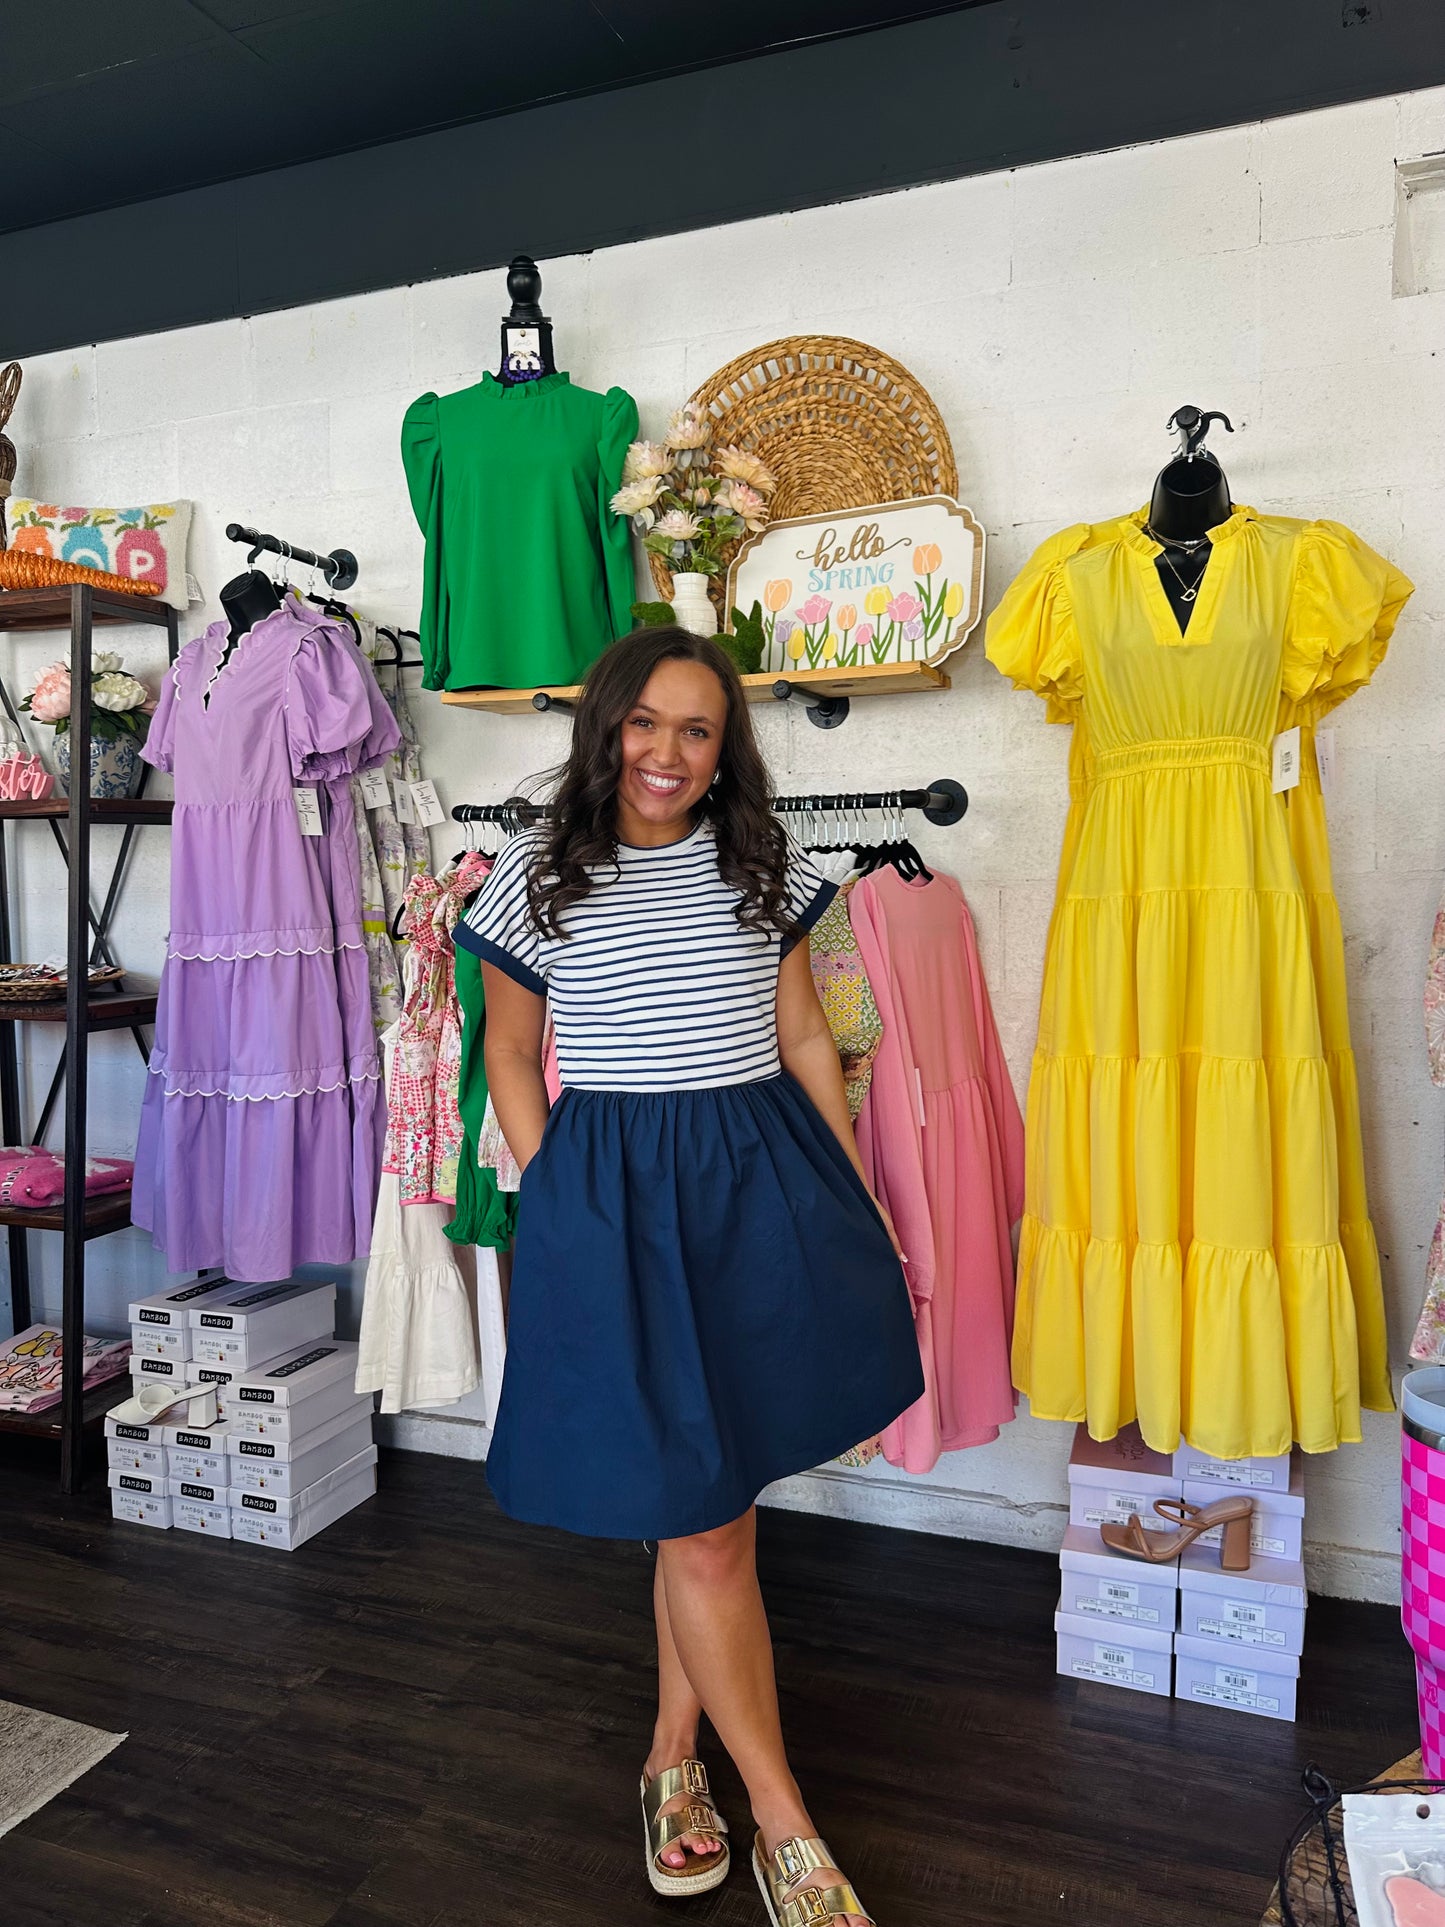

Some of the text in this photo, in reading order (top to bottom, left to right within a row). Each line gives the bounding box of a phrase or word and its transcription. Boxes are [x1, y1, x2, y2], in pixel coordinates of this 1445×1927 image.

[796, 523, 912, 571] hello
[807, 562, 895, 593] SPRING
[140, 1312, 169, 1322] BAMBOO
[202, 1316, 232, 1327] BAMBOO
[143, 1362, 171, 1372] BAMBOO
[200, 1372, 230, 1382] BAMBOO
[241, 1390, 272, 1401] BAMBOO
[117, 1427, 147, 1438] BAMBOO
[178, 1435, 209, 1446] BAMBOO
[241, 1443, 273, 1455] BAMBOO
[121, 1478, 150, 1490] BAMBOO
[182, 1486, 212, 1498] BAMBOO
[244, 1497, 275, 1510] BAMBOO
